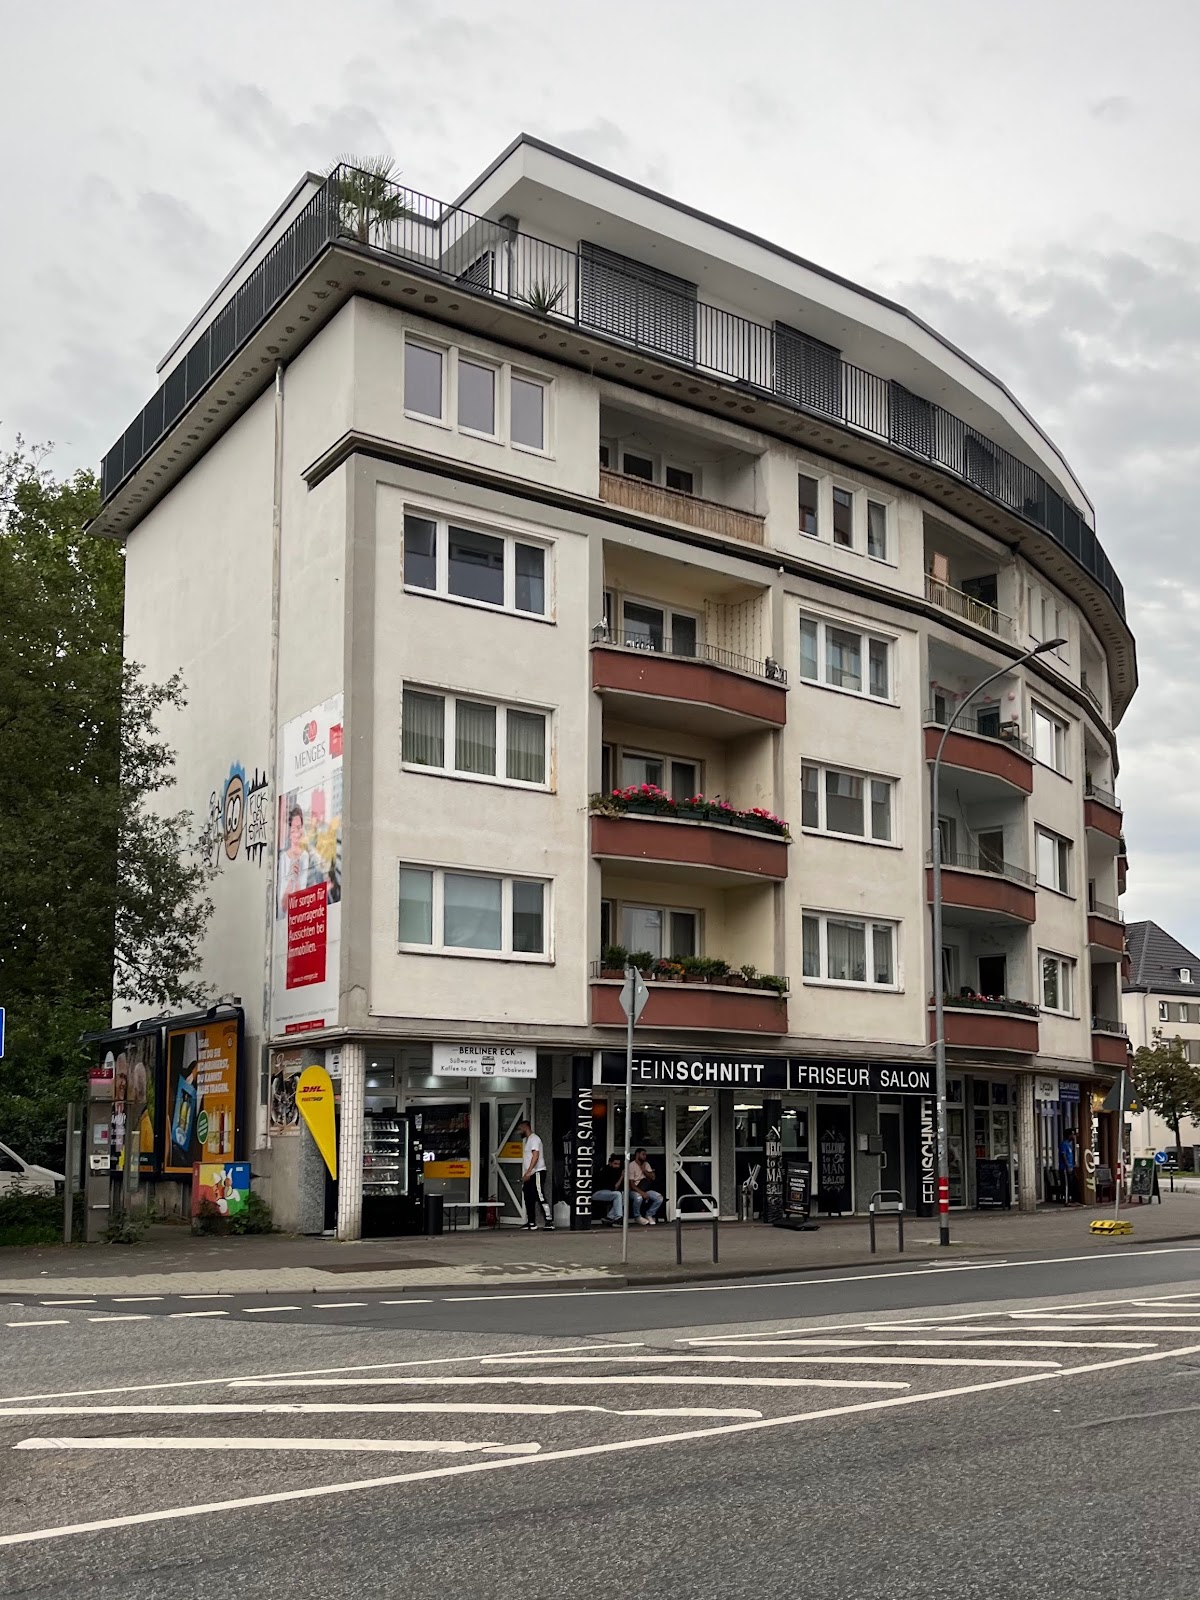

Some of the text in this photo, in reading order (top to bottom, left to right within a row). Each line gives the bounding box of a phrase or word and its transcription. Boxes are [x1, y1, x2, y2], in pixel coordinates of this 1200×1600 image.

[295, 741, 326, 770] MENGES
[289, 888, 325, 910] Wir sorgen für
[289, 905, 325, 926] hervorragende
[289, 921, 325, 942] Aussichten bei
[459, 1046, 516, 1056] BERLINER ECK
[468, 1065, 478, 1073] Go
[501, 1066, 534, 1074] Tabakwaren
[501, 1058, 526, 1066] Getränke
[630, 1060, 764, 1082] FEINSCHNITT
[798, 1066, 930, 1089] FRISEUR SALON
[821, 1142, 846, 1154] WELCOME
[920, 1096, 935, 1204] FEINSCHNITT
[822, 1163, 845, 1174] MAN
[576, 1146, 593, 1216] FRISEUR
[822, 1175, 846, 1185] SALON
